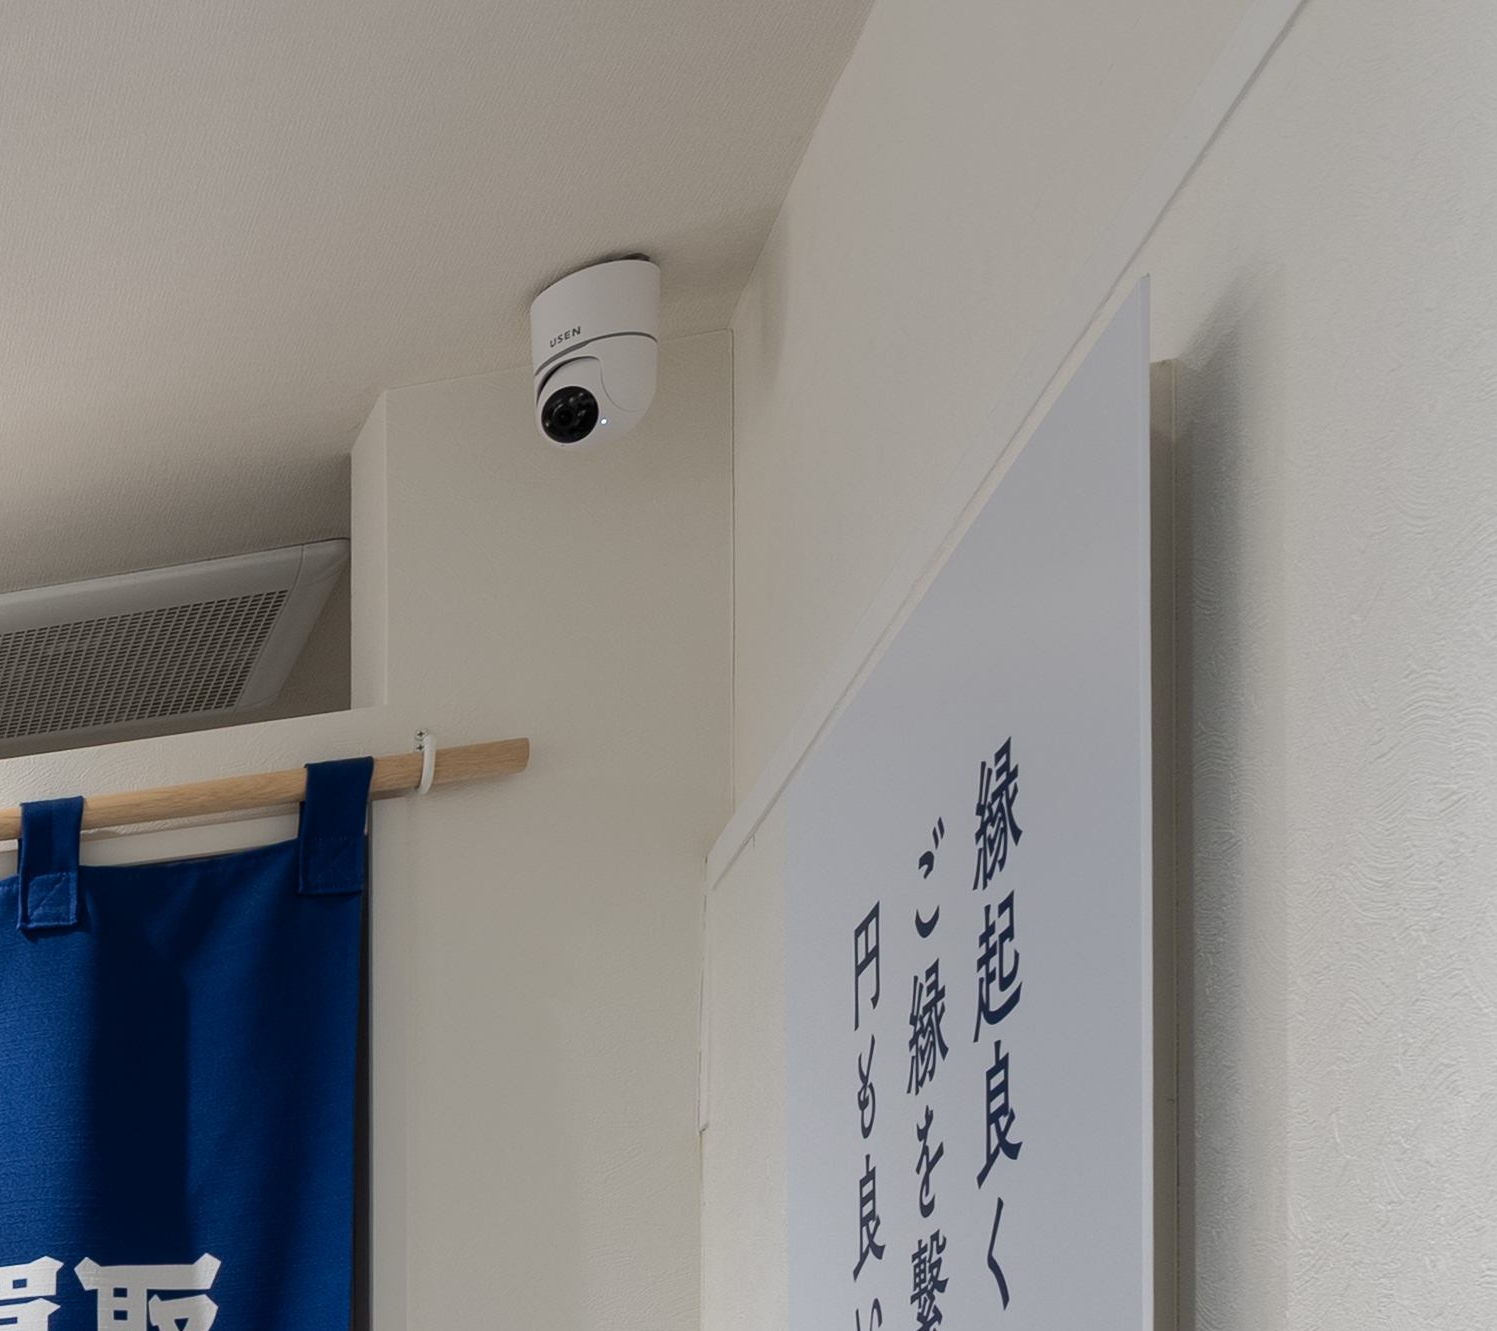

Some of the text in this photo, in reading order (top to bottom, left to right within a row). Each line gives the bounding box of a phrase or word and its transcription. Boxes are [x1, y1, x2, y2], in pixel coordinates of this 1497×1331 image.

[550, 326, 582, 348] USEN
[972, 736, 1023, 1310] 縁起良く
